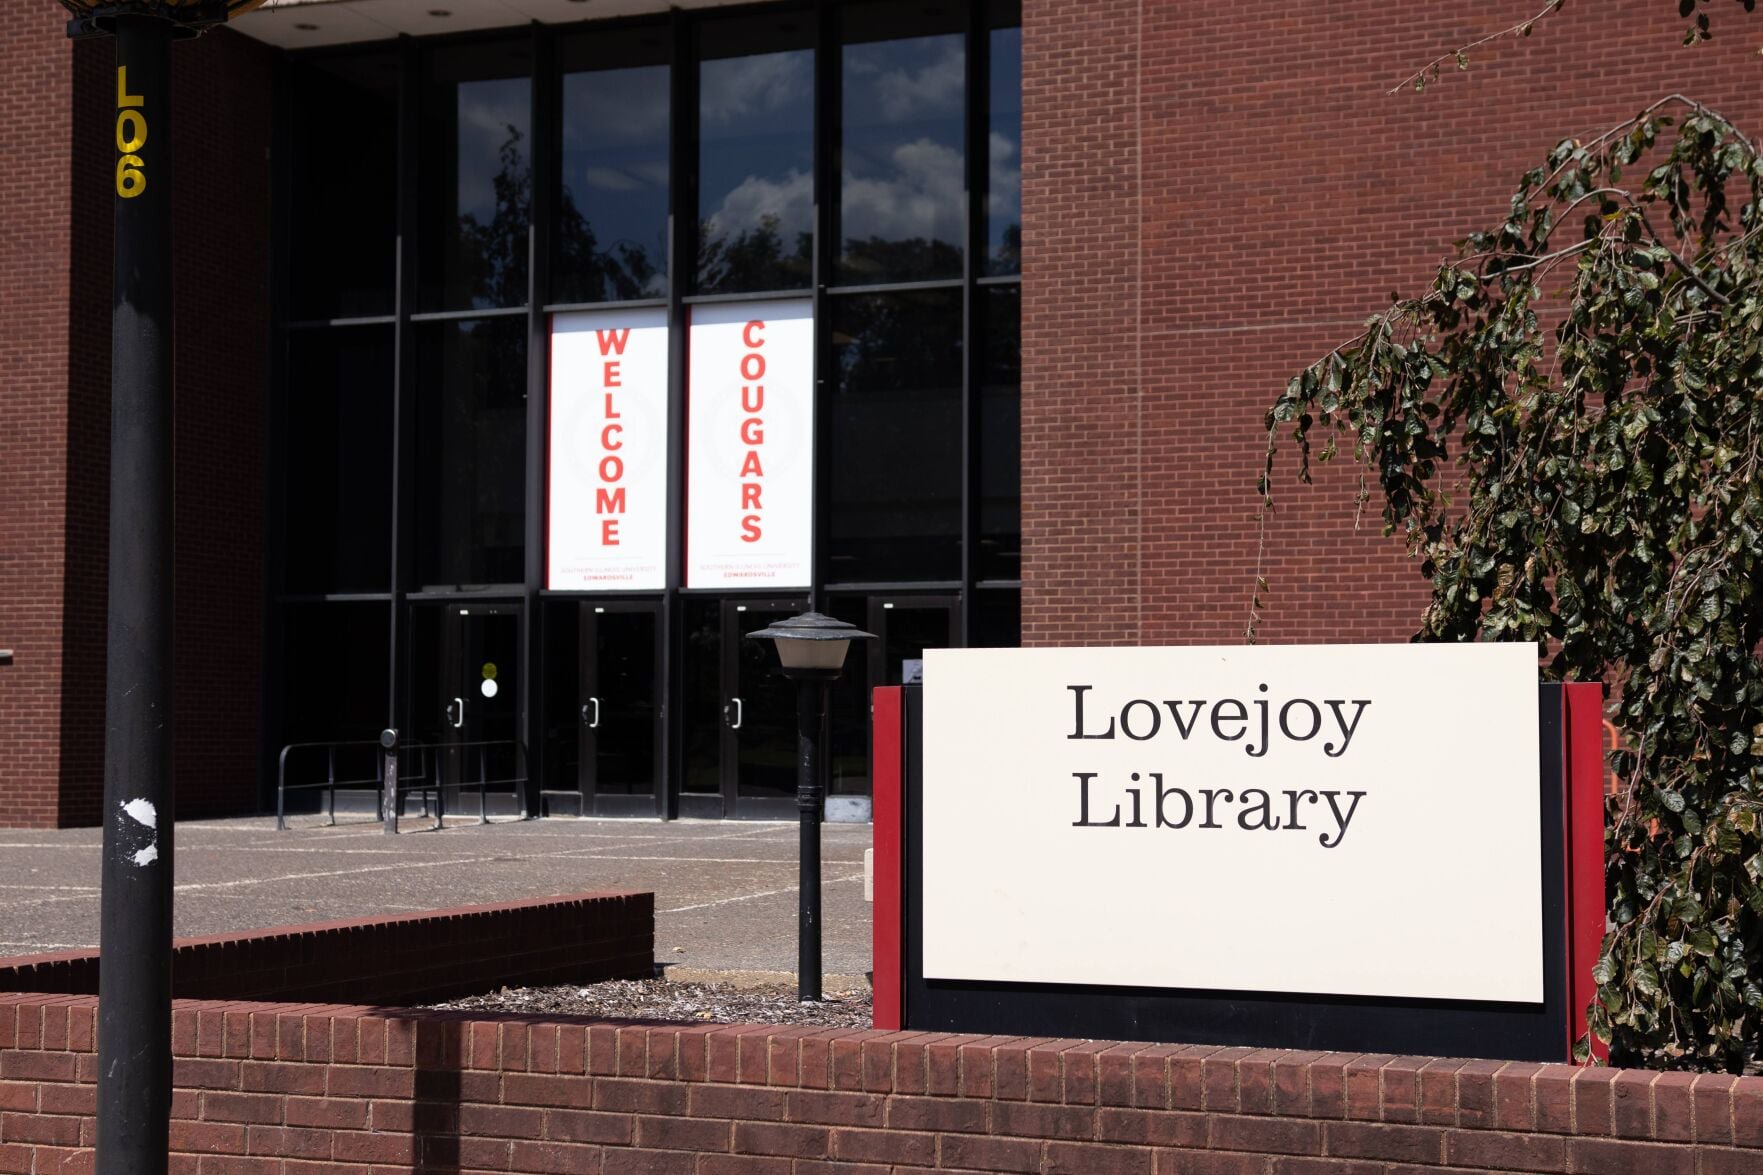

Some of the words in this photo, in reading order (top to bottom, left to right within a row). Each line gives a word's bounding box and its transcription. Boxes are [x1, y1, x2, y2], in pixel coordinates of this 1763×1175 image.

[595, 328, 630, 546] WELCOME
[739, 320, 767, 543] COUGARS
[1066, 683, 1372, 758] Lovejoy
[1071, 772, 1367, 849] Library
